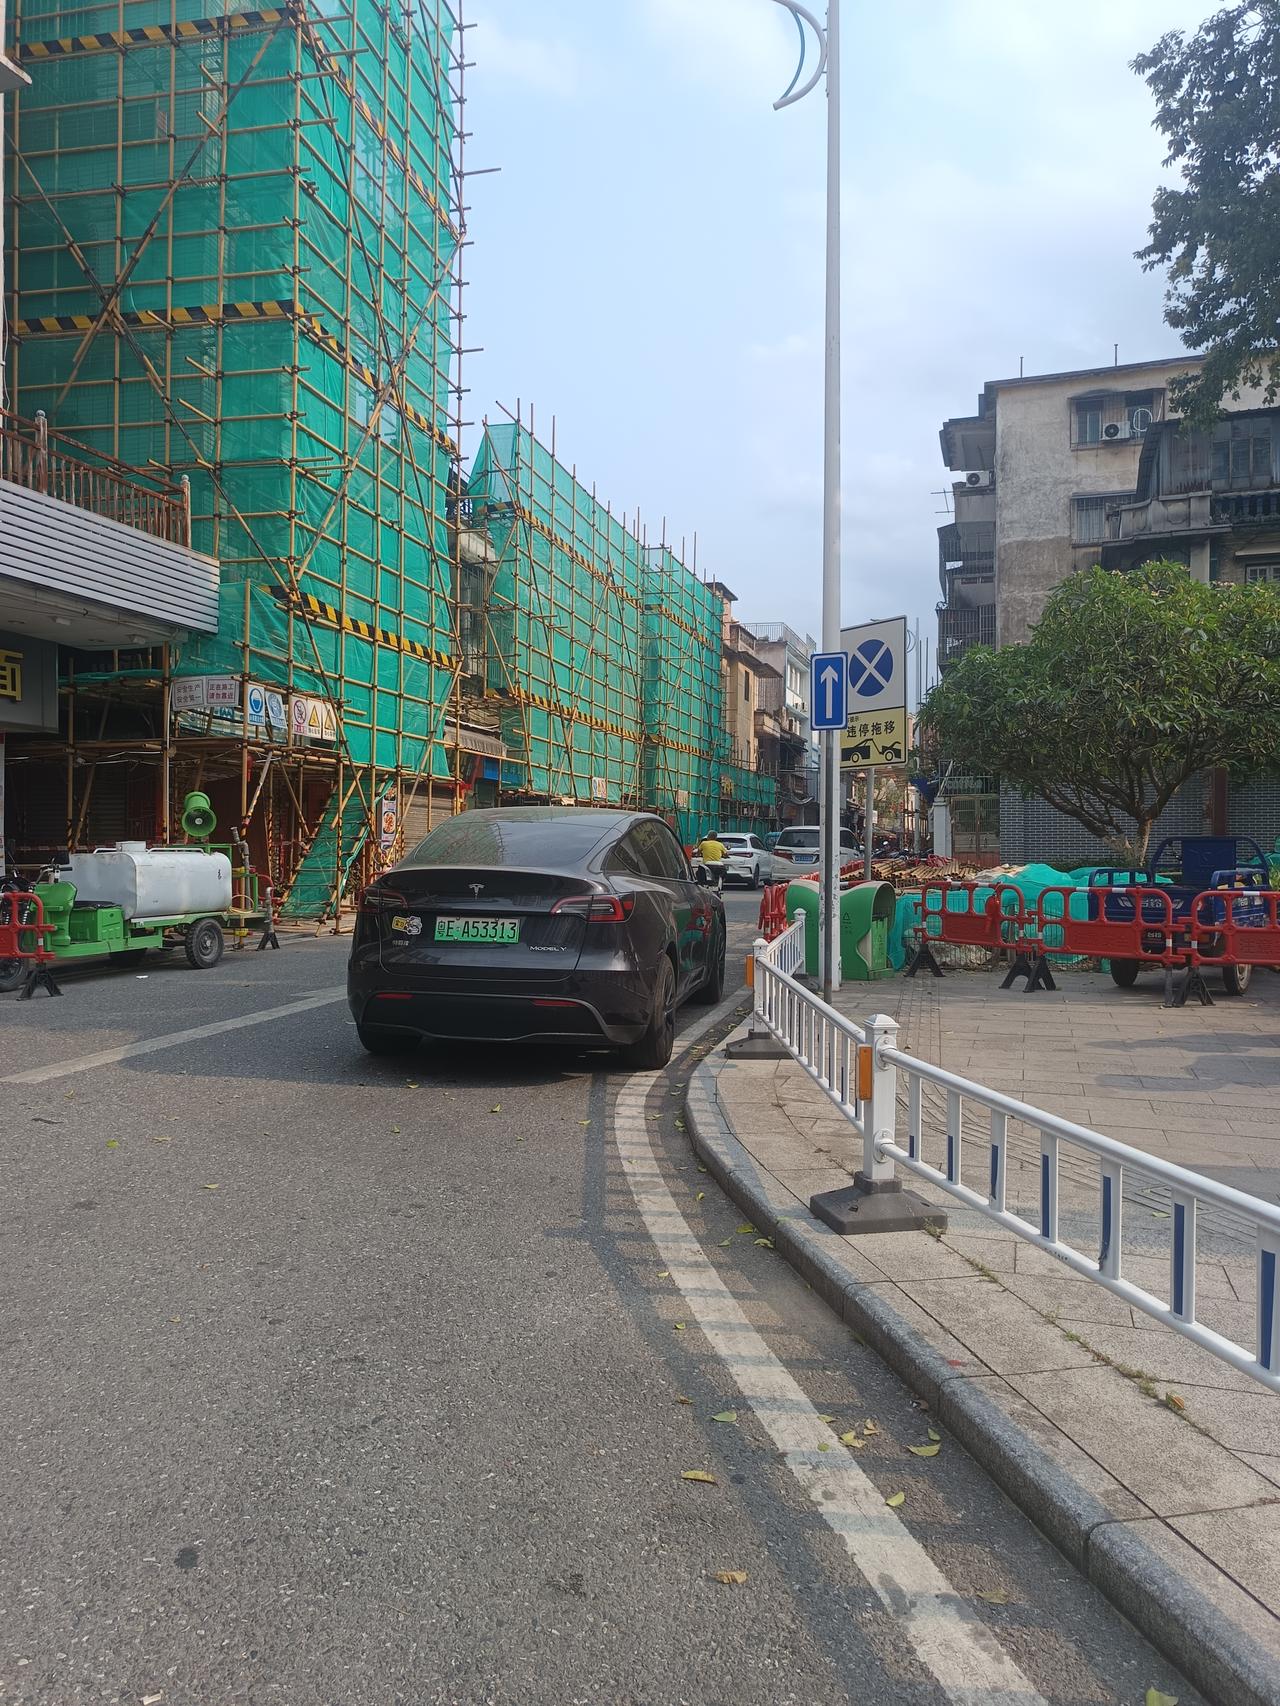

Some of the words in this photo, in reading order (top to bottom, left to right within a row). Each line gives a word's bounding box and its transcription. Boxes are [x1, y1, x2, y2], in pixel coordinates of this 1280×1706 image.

[176, 683, 201, 693] 安全生产
[209, 683, 234, 691] 正在施工
[847, 720, 895, 738] 违停拖移
